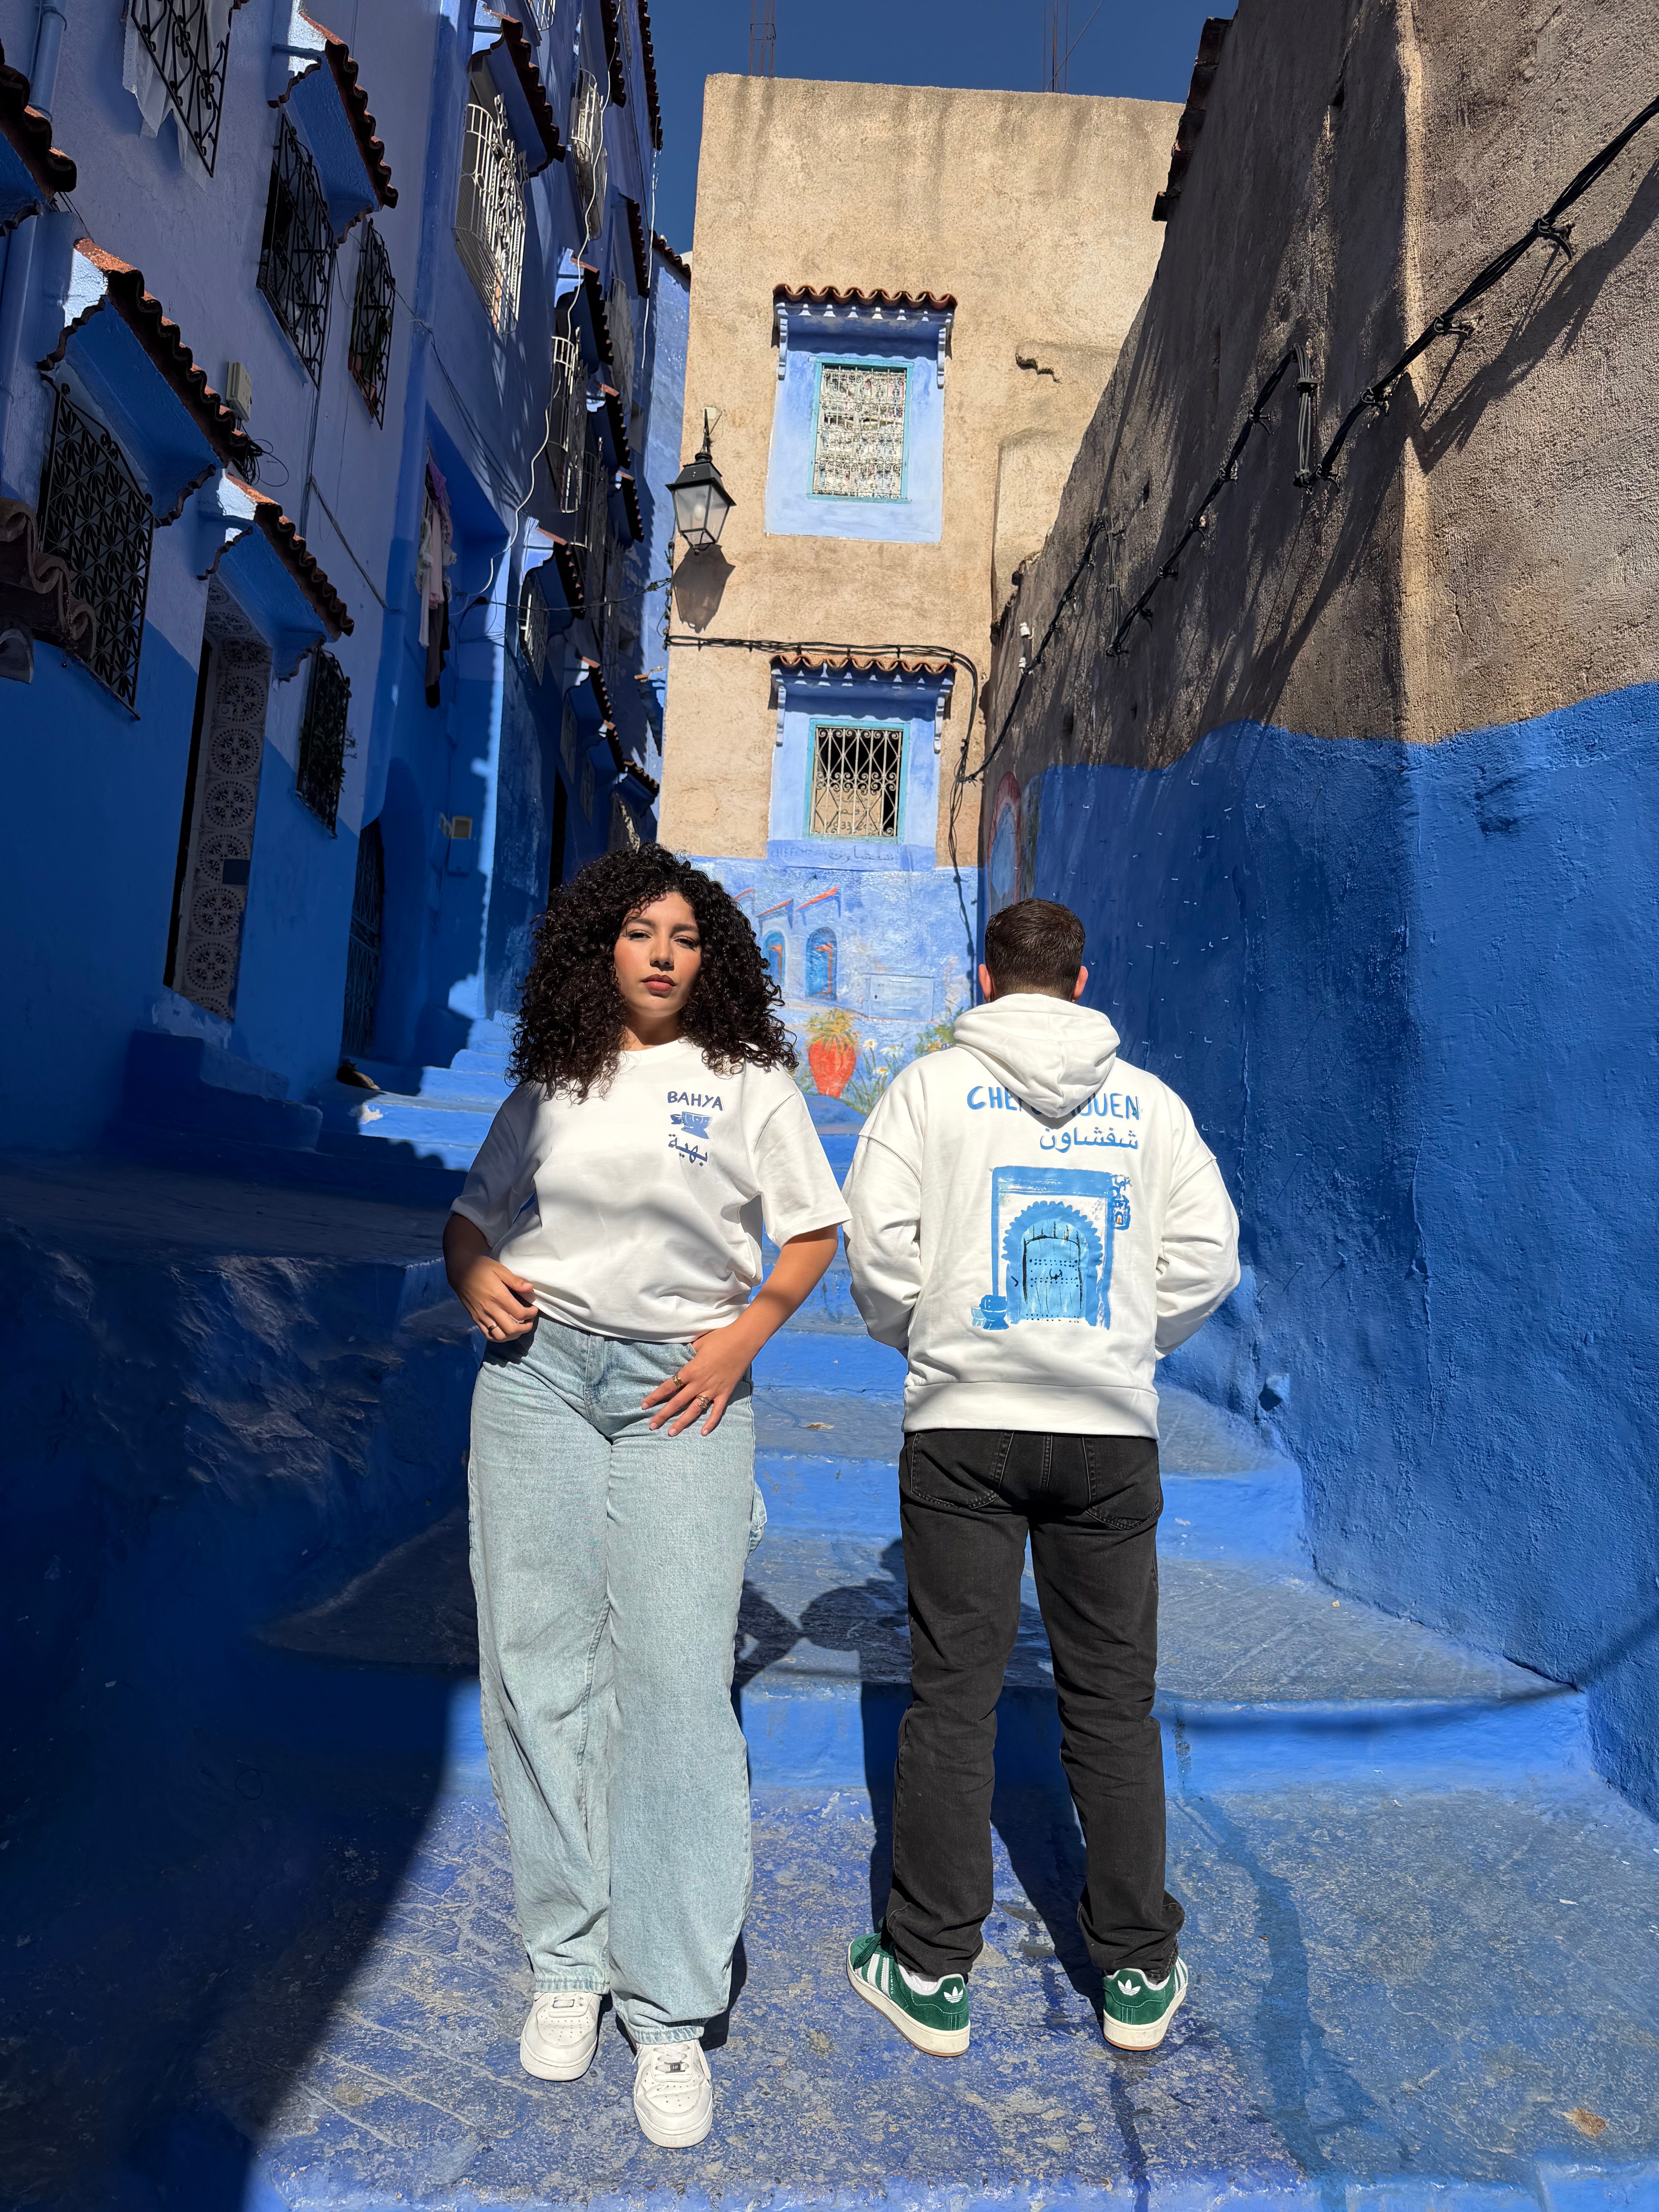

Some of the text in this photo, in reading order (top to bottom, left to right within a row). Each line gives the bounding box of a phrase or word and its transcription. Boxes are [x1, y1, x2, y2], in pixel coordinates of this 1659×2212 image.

[667, 1091, 723, 1111] BAHYA
[668, 1133, 708, 1167] بهية
[1040, 1127, 1139, 1153] شفشاون
